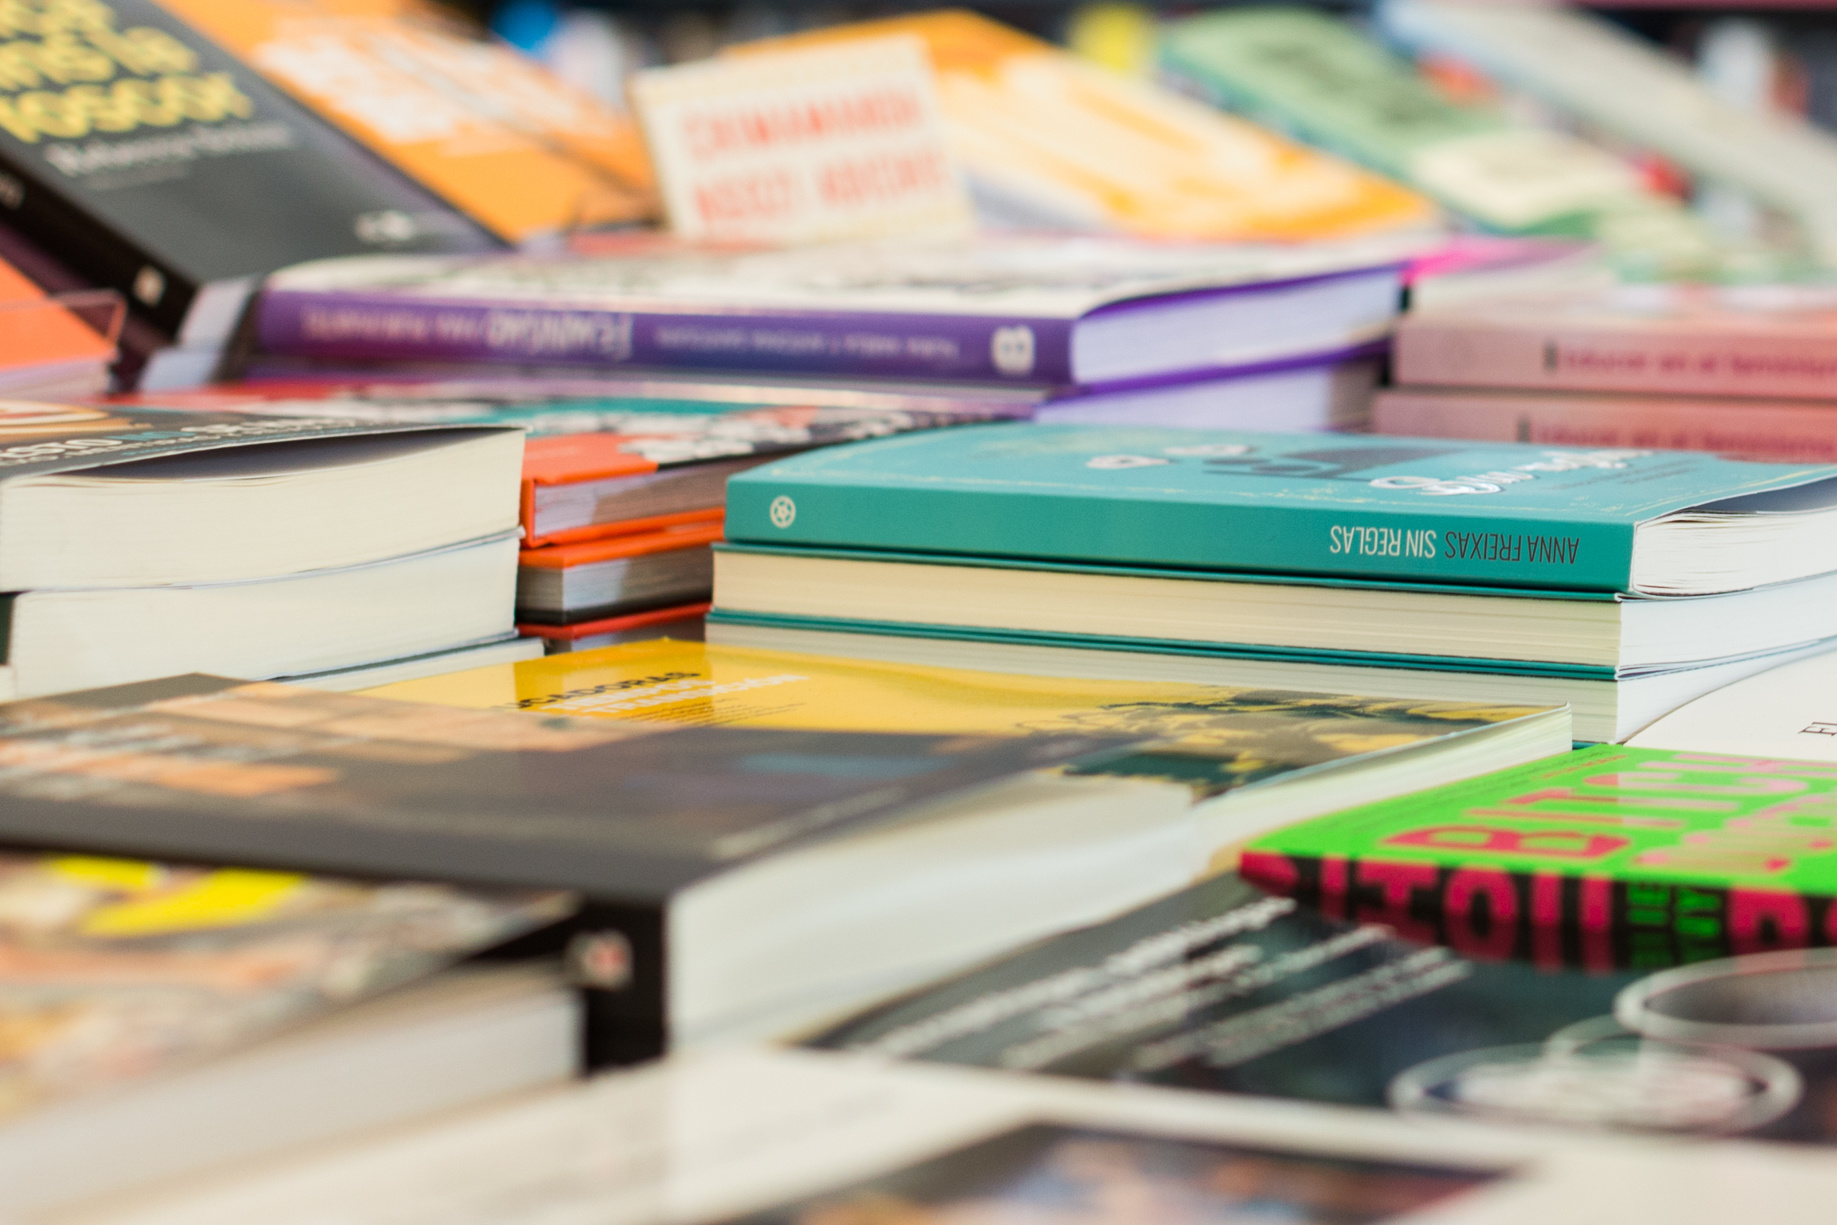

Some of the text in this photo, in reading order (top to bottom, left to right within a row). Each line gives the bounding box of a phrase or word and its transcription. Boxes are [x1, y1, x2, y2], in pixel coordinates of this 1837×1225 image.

[1329, 525, 1581, 565] ANNA FREIXAS SIN REGLAS
